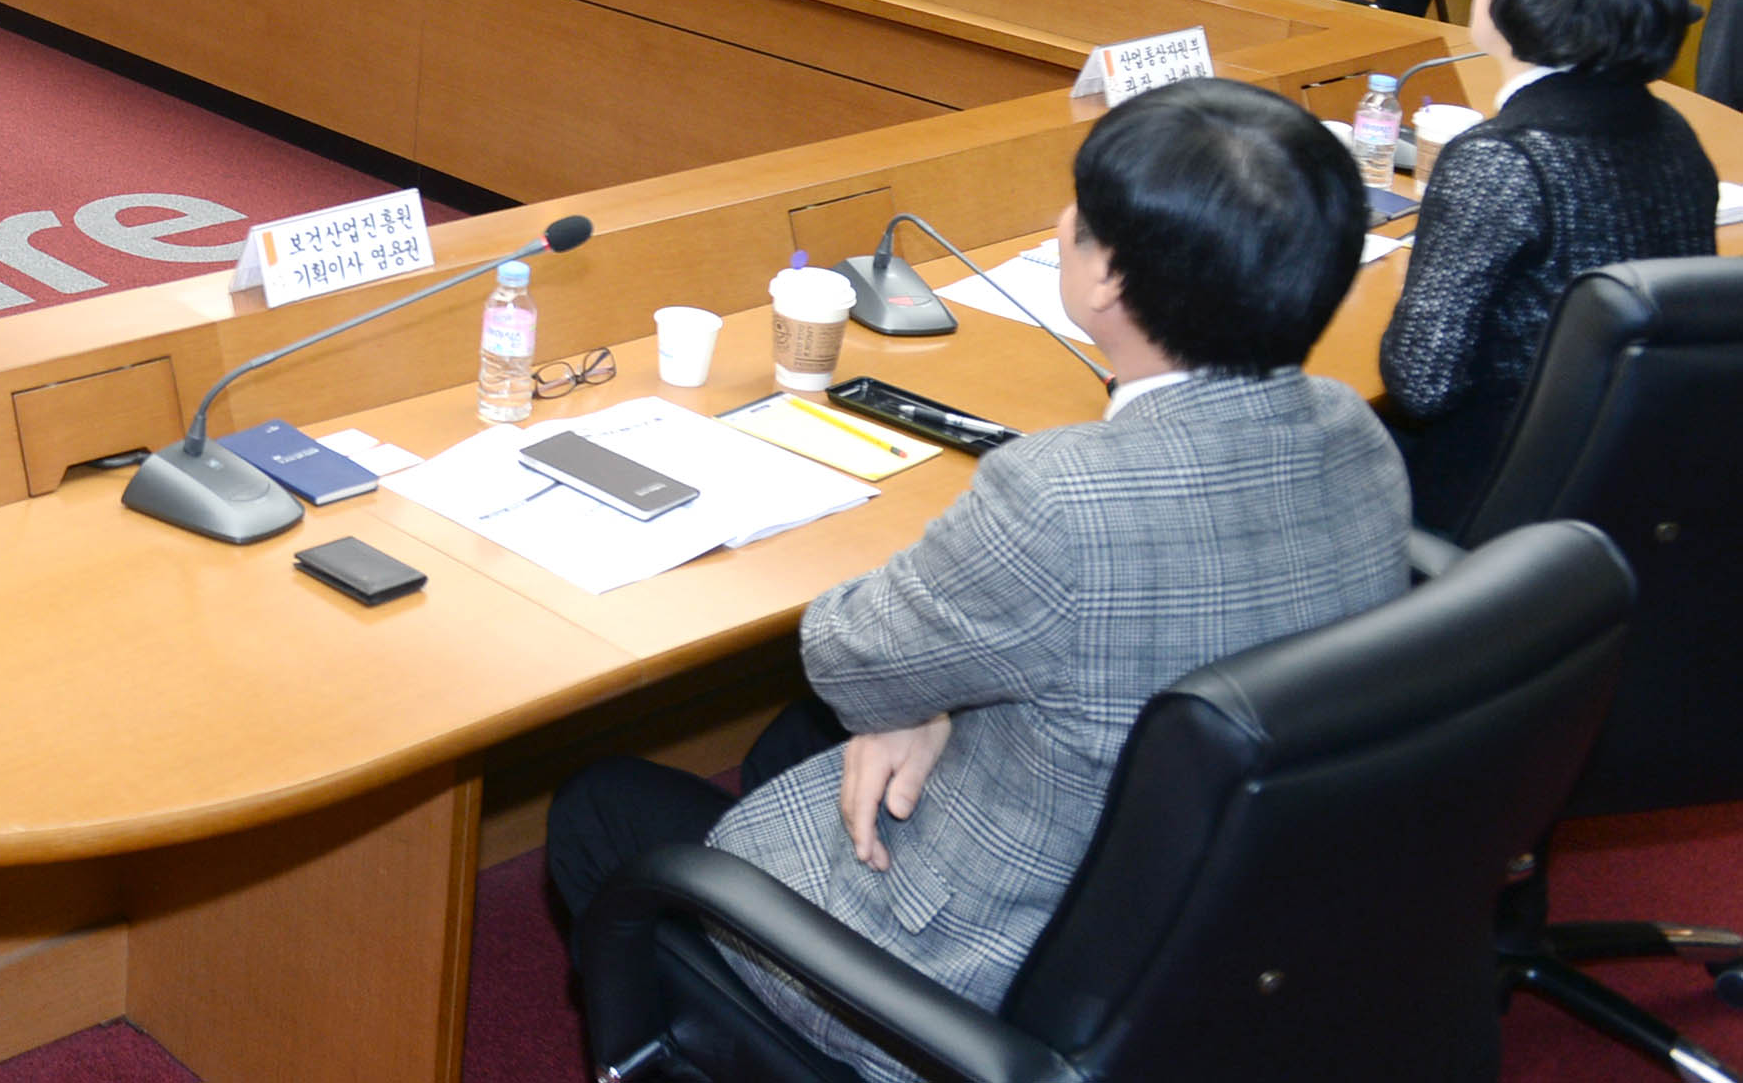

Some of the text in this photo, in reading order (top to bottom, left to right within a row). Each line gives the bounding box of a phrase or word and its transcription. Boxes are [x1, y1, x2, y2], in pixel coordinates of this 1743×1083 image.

[1119, 37, 1201, 72] 산업통상자원부
[289, 203, 413, 256] 보건산업진흥원
[294, 251, 365, 289] 기획이사
